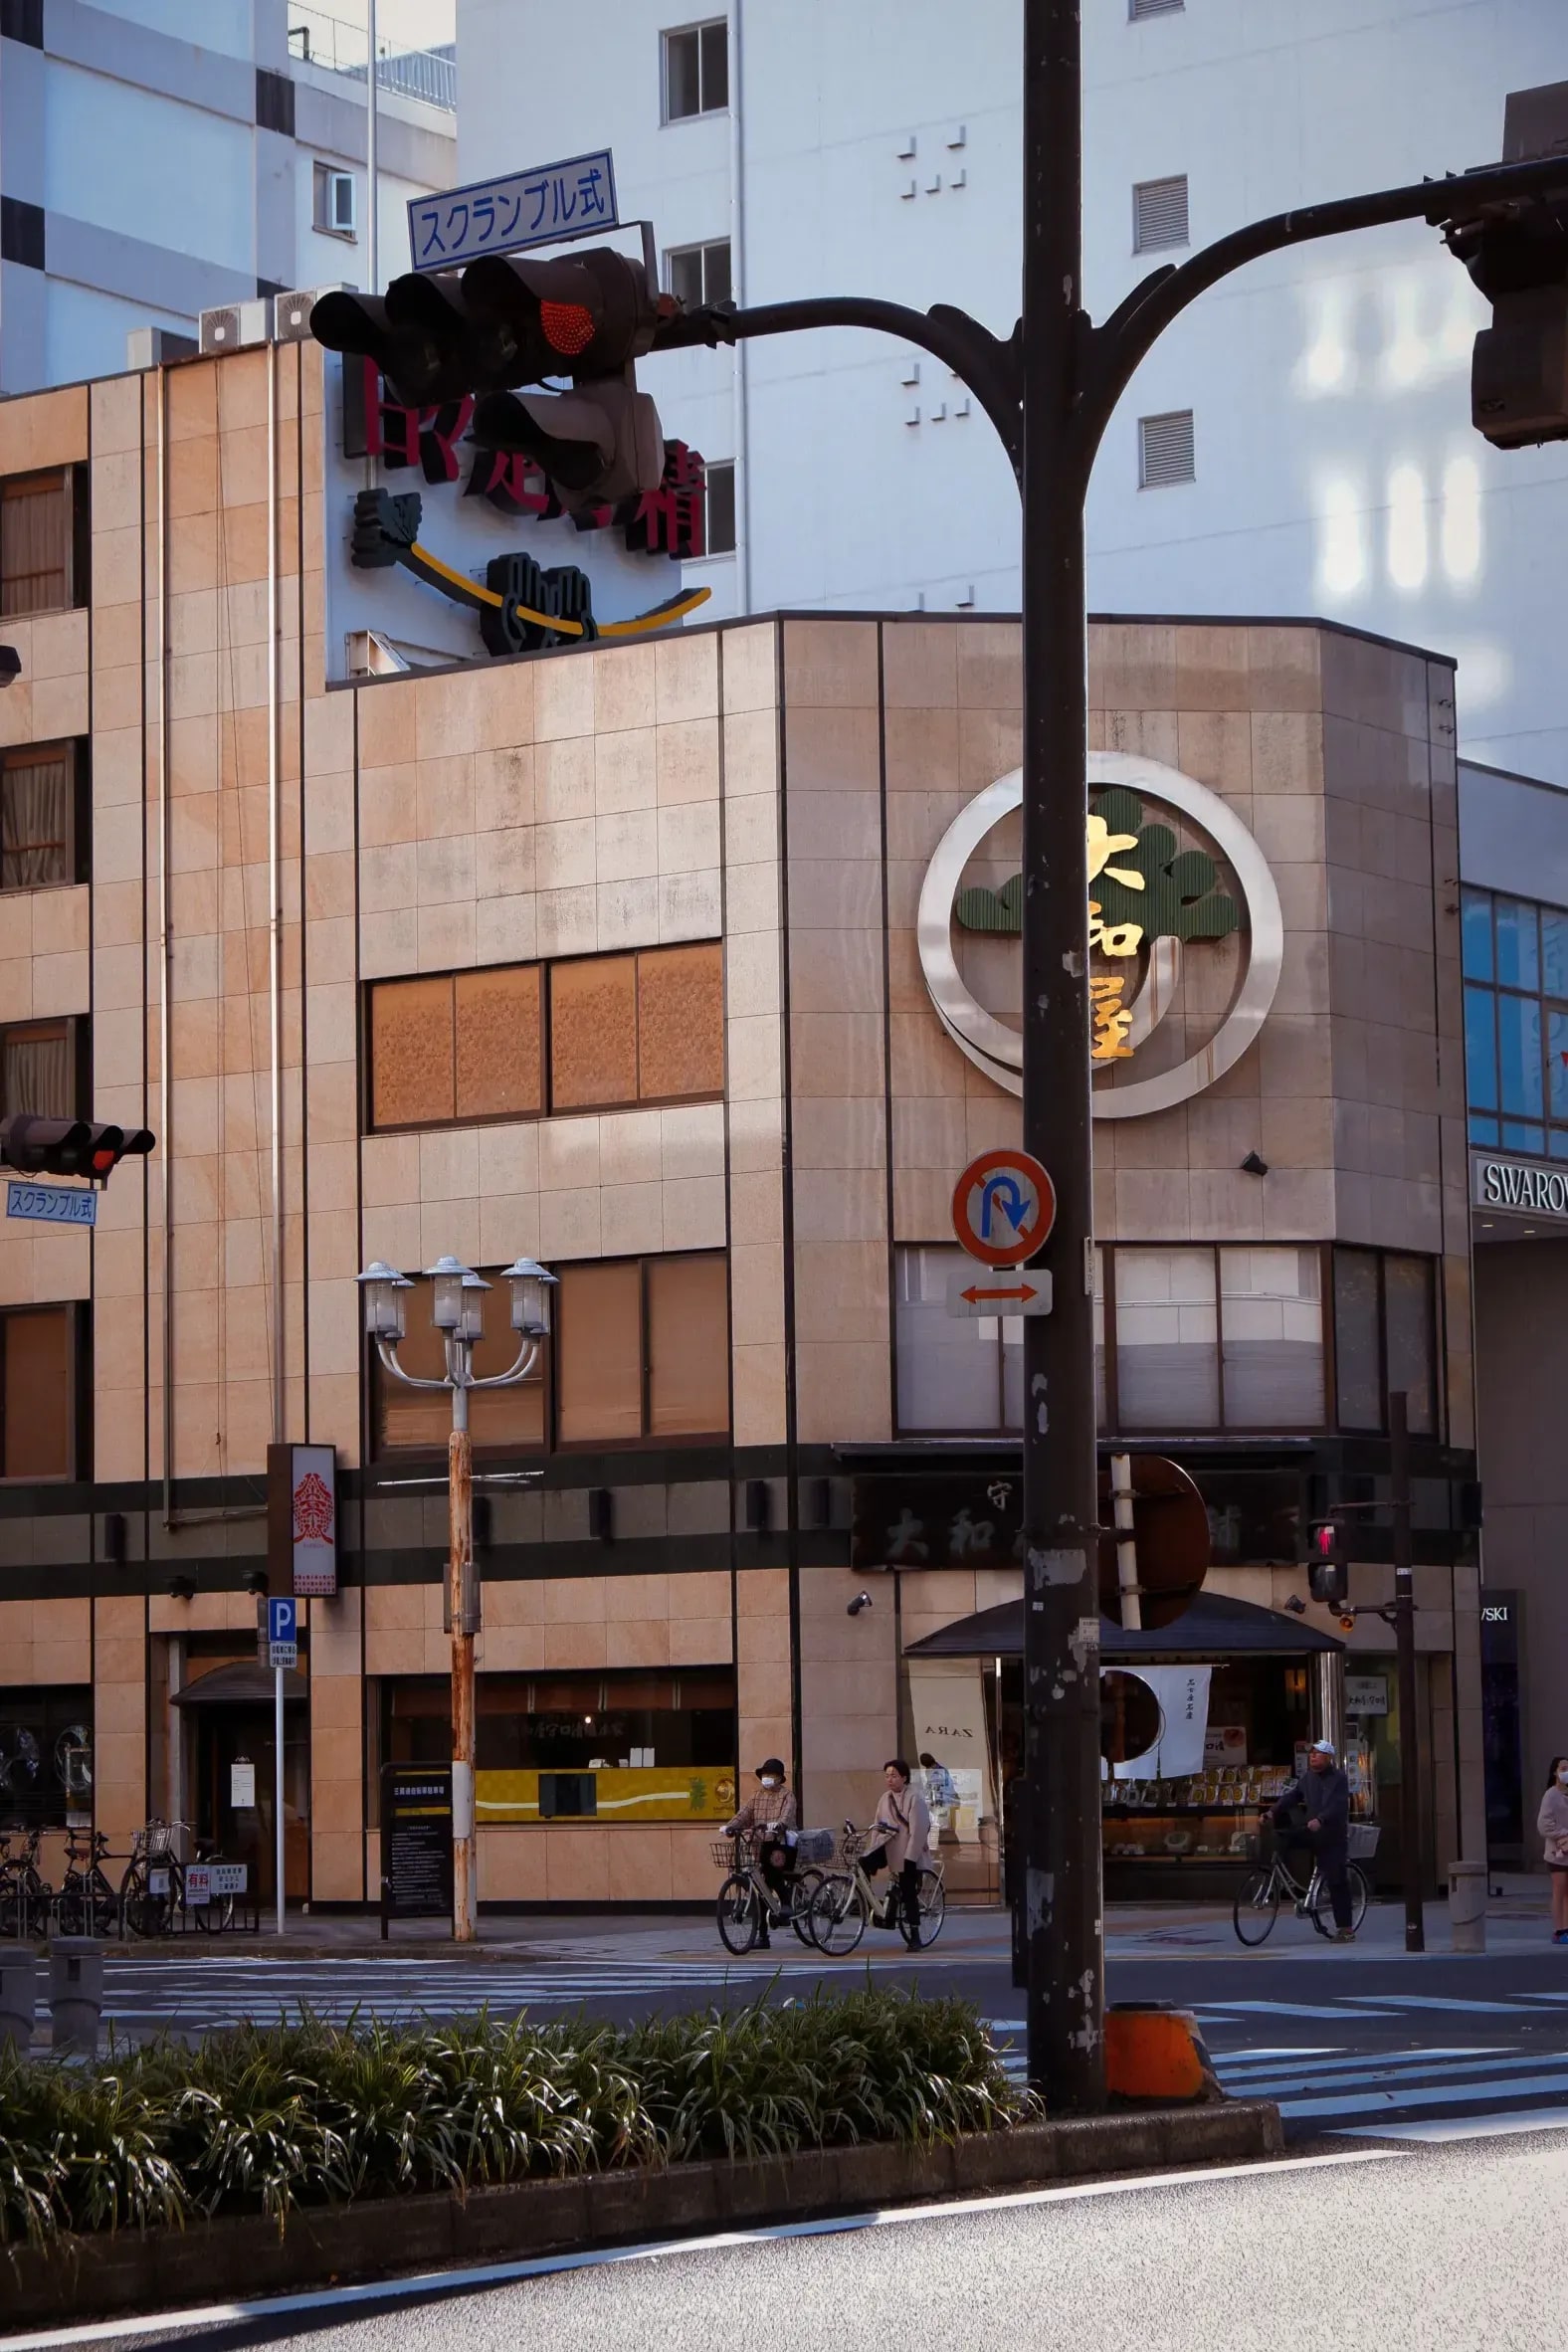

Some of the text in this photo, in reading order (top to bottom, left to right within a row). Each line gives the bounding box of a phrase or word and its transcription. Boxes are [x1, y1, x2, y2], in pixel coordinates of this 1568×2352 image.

[421, 167, 605, 257] スクランブル式
[11, 1190, 93, 1219] スクランブル式
[276, 1602, 292, 1638] P
